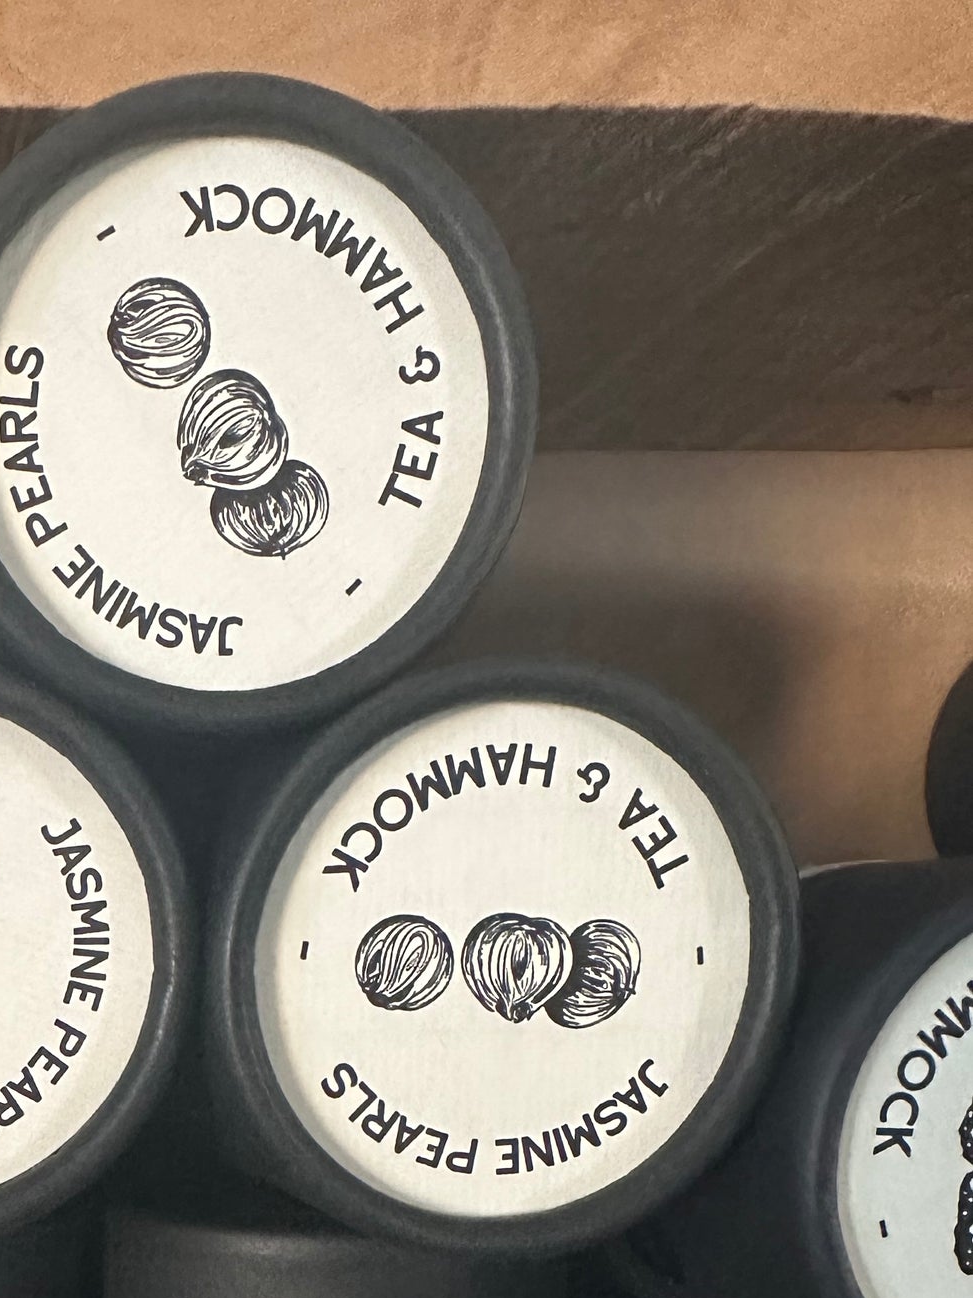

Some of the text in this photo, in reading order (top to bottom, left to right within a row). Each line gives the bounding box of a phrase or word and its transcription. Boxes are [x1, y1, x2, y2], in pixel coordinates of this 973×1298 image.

[179, 184, 444, 509] TEA & HAMMOCK
[0, 345, 243, 657] JASMINE PEARLS
[41, 817, 110, 1013] JASMINE
[322, 743, 689, 893] TEA & HAMMOCK
[321, 1058, 669, 1176] JASMINE PEARLS
